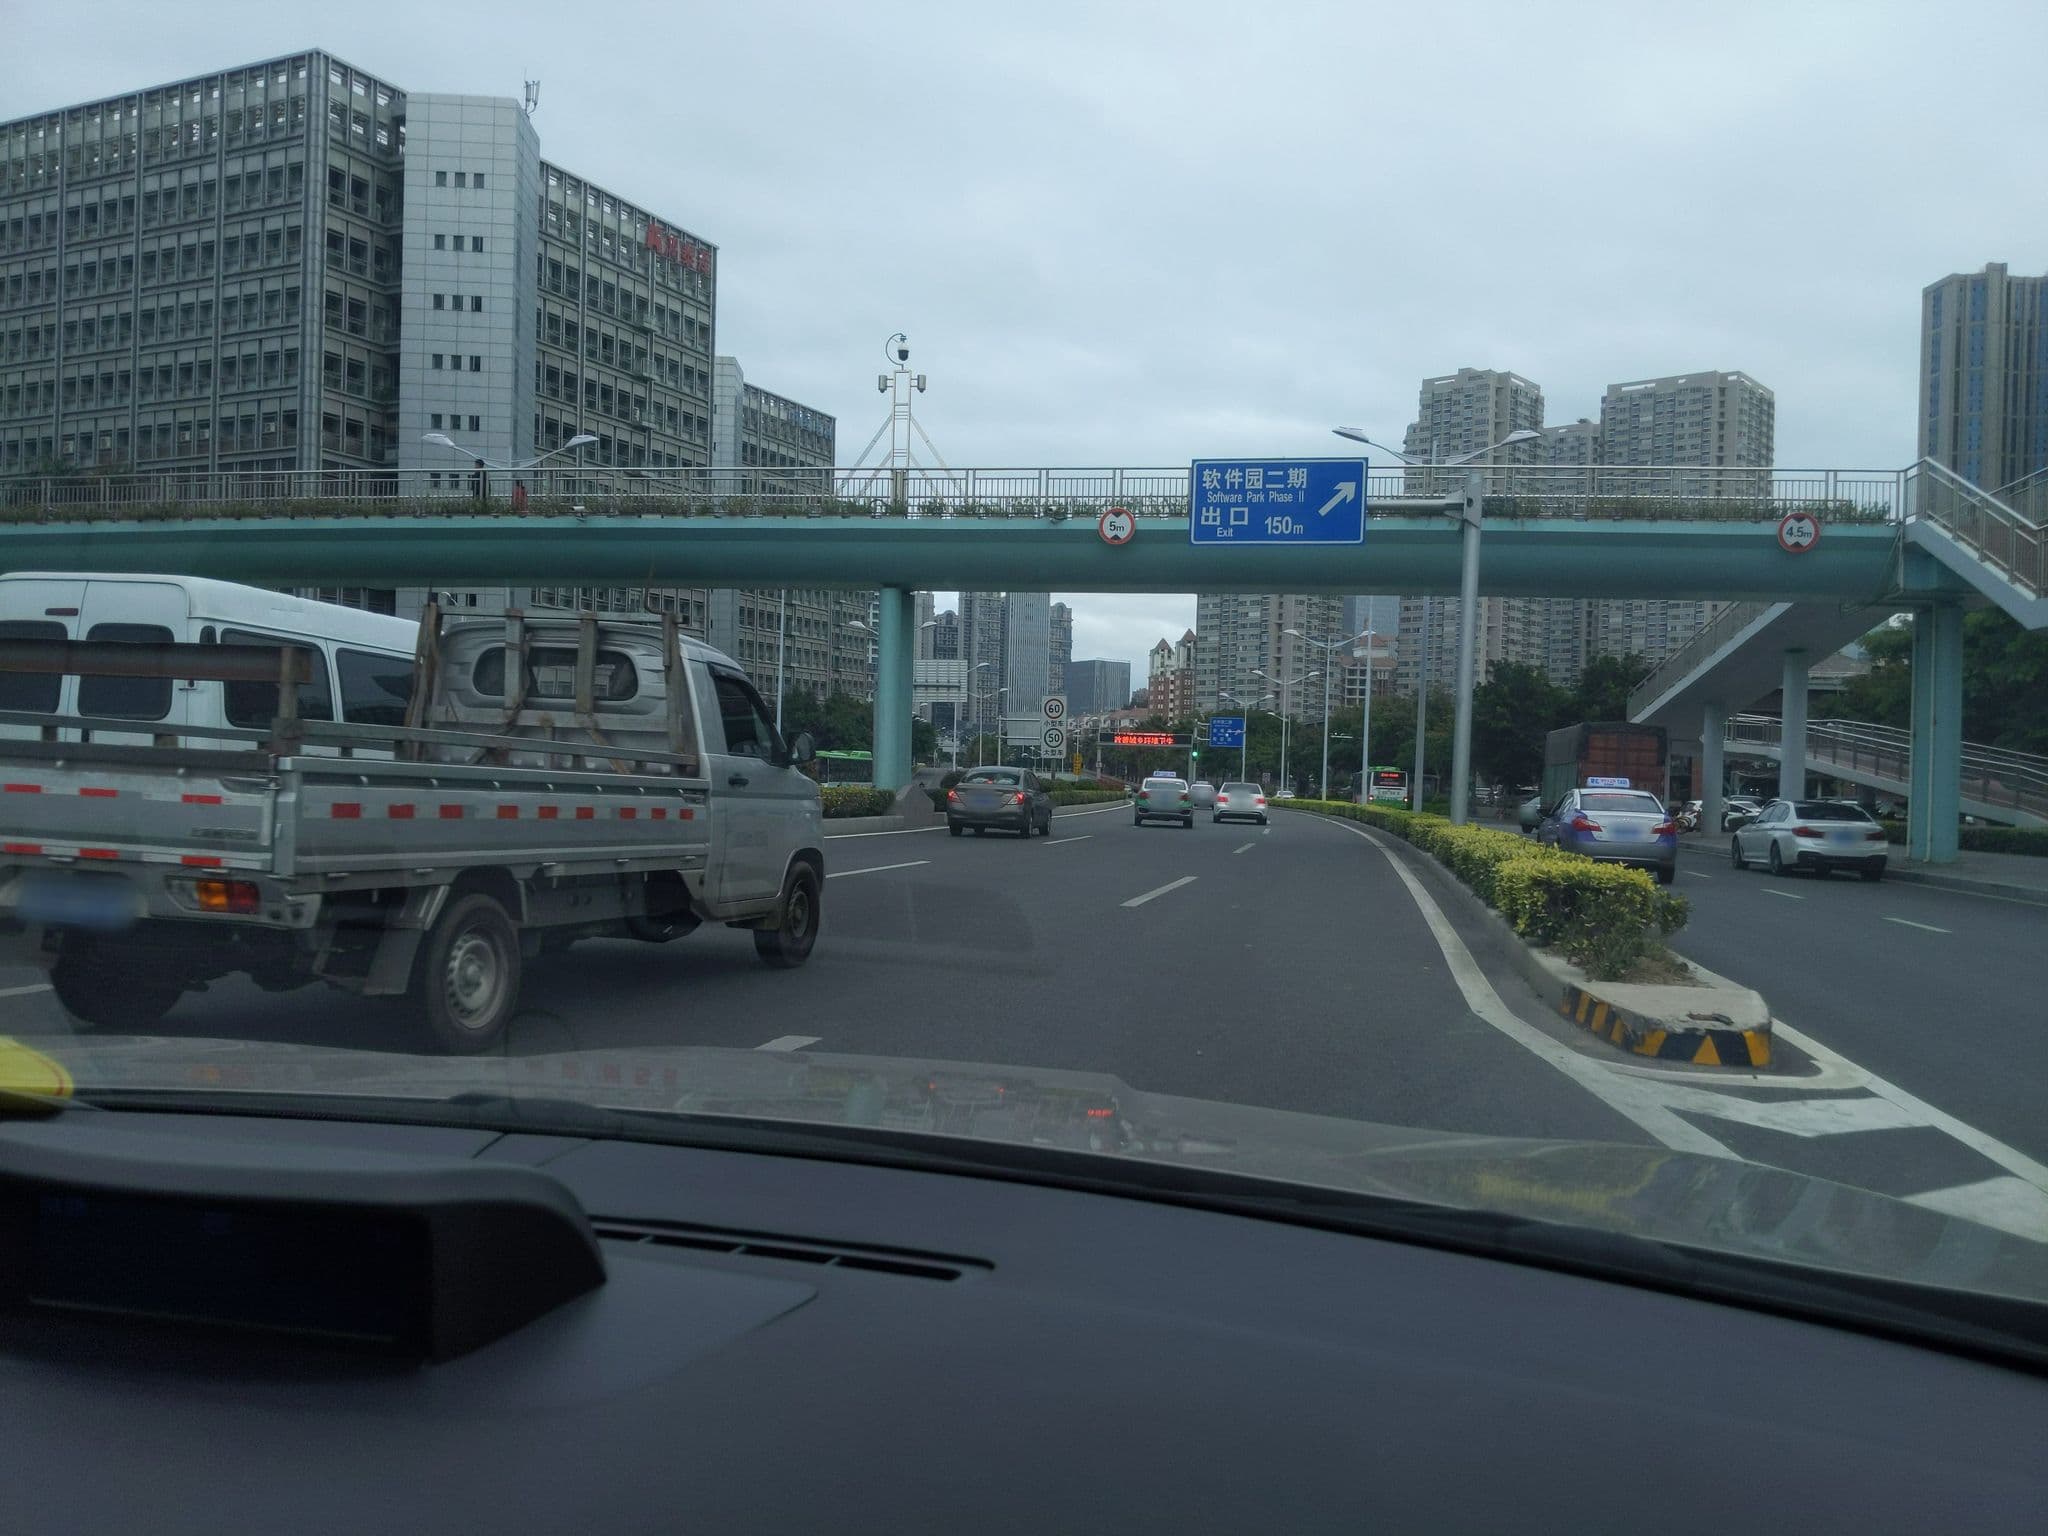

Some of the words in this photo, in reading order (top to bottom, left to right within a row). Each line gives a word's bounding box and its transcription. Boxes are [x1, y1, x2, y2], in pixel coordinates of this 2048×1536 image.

[1202, 468, 1307, 490] 软件园二期
[1207, 491, 1243, 503] Software
[1246, 491, 1265, 503] Park
[1269, 491, 1293, 503] Phase
[1200, 506, 1249, 526] 出口
[1109, 521, 1125, 532] 5m
[1264, 516, 1304, 535] 150m
[1216, 527, 1234, 537] Exit
[1786, 526, 1812, 538] 4.5m
[1048, 704, 1060, 714] 60
[1043, 720, 1065, 728] 小型车
[1048, 733, 1060, 743] 50
[1043, 749, 1064, 757] 大型车
